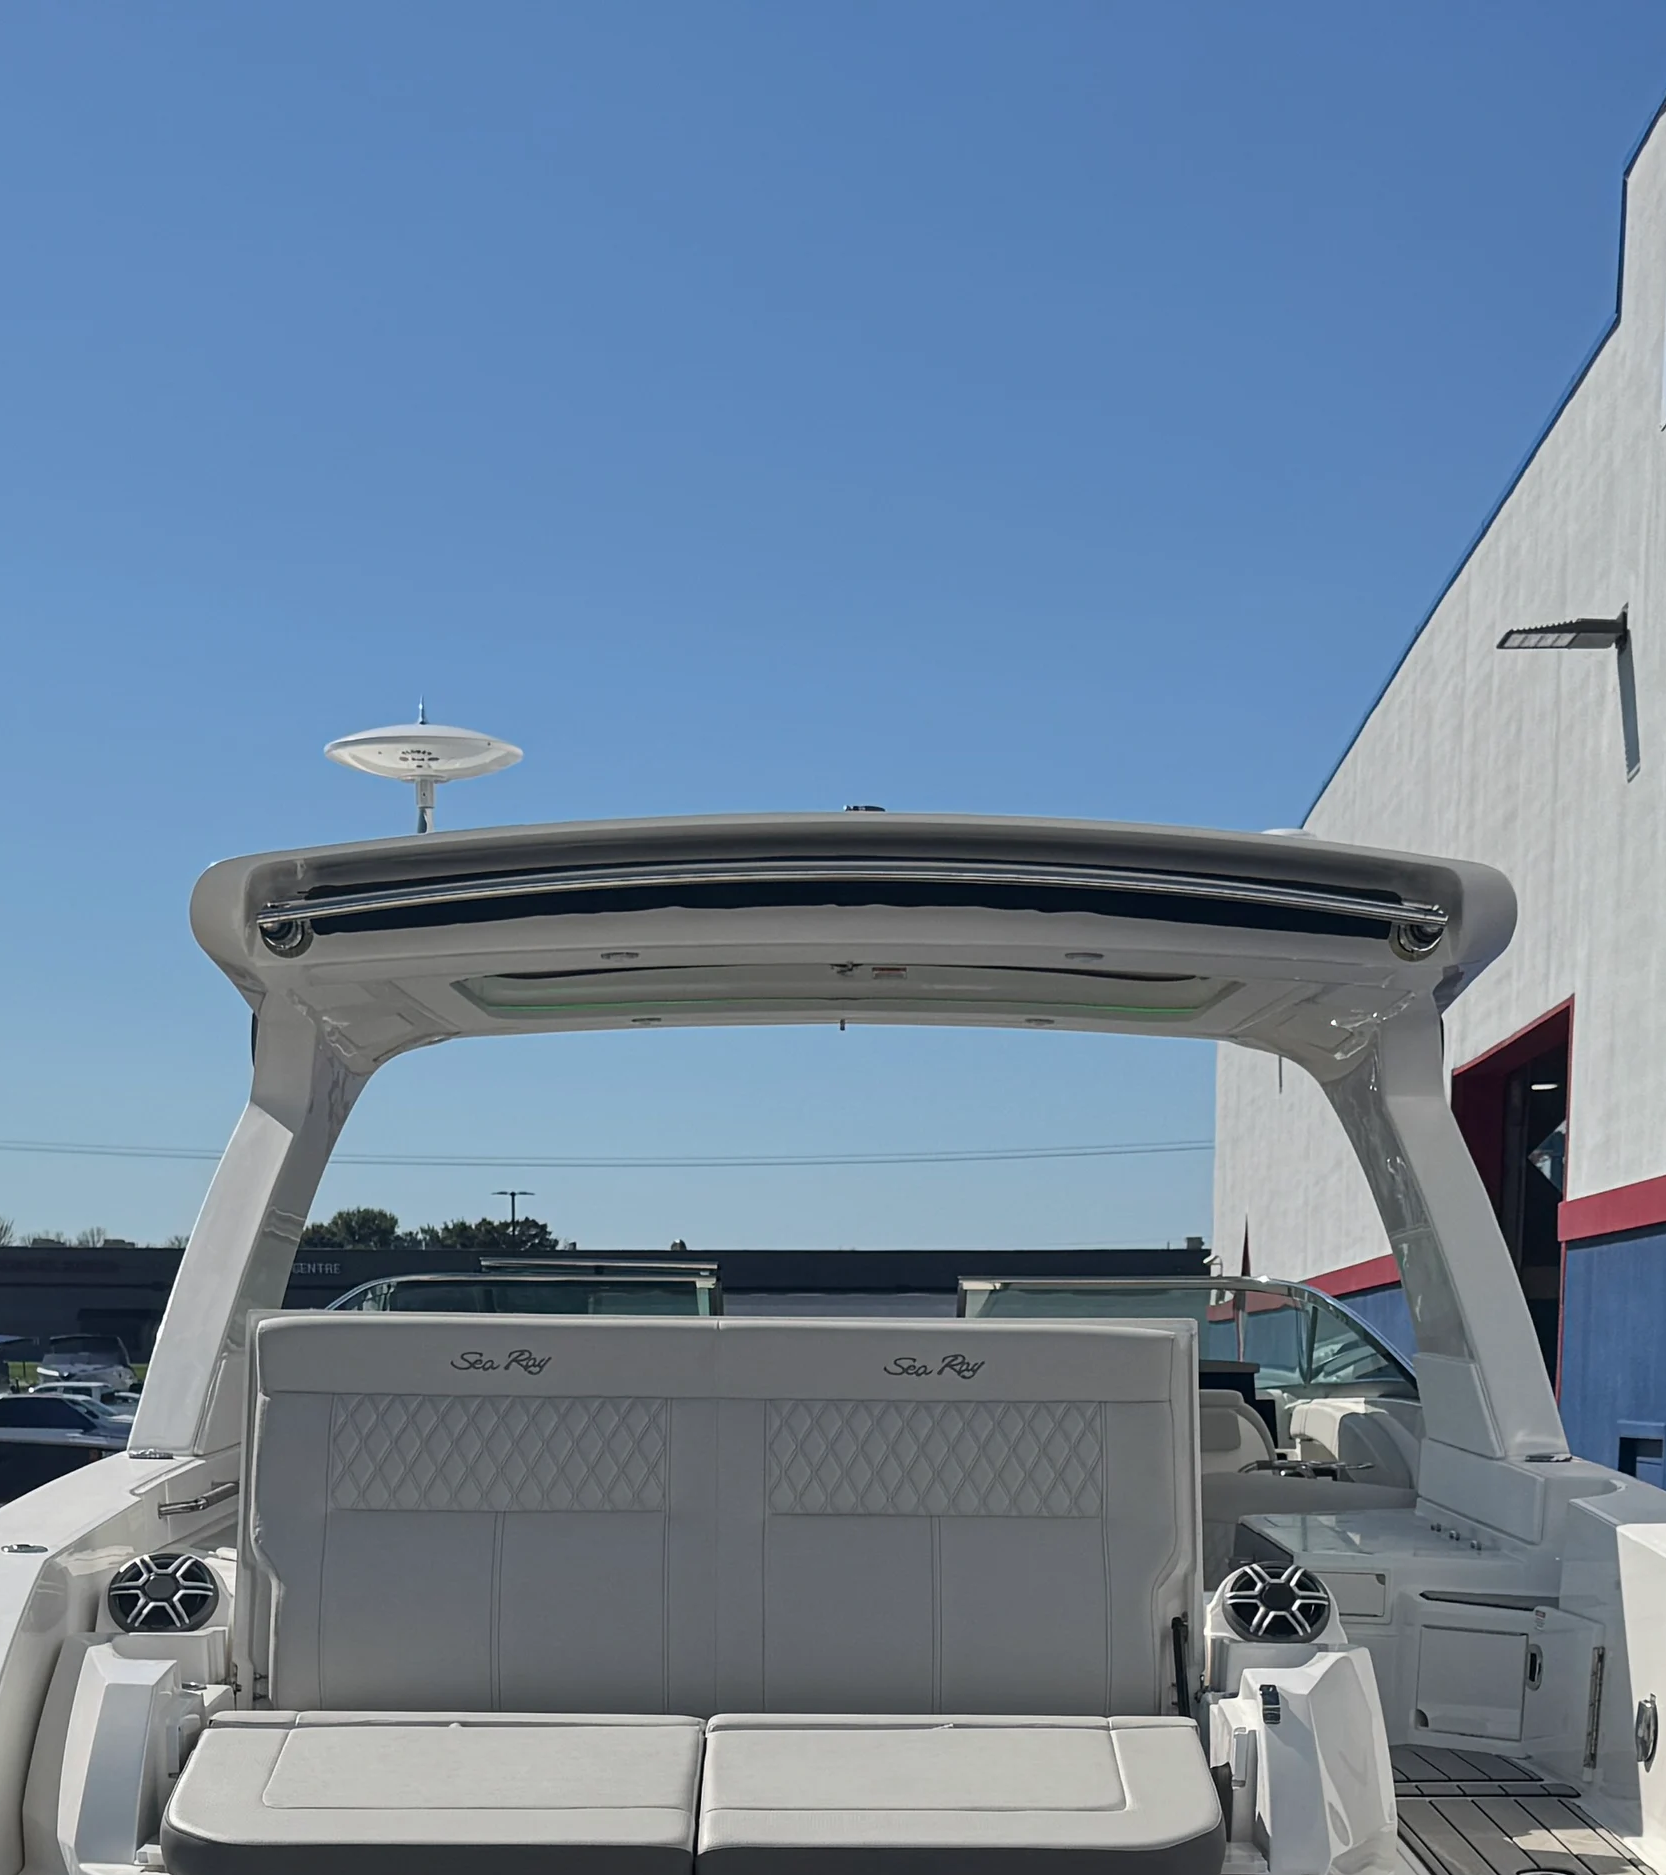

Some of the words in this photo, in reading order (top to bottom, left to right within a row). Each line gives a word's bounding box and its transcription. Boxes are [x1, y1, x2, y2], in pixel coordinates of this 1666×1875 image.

[293, 1262, 341, 1274] CENTRE
[450, 1351, 501, 1372] Sea
[503, 1349, 552, 1375] Ray
[883, 1357, 934, 1377] Sea
[936, 1353, 985, 1380] Ray
